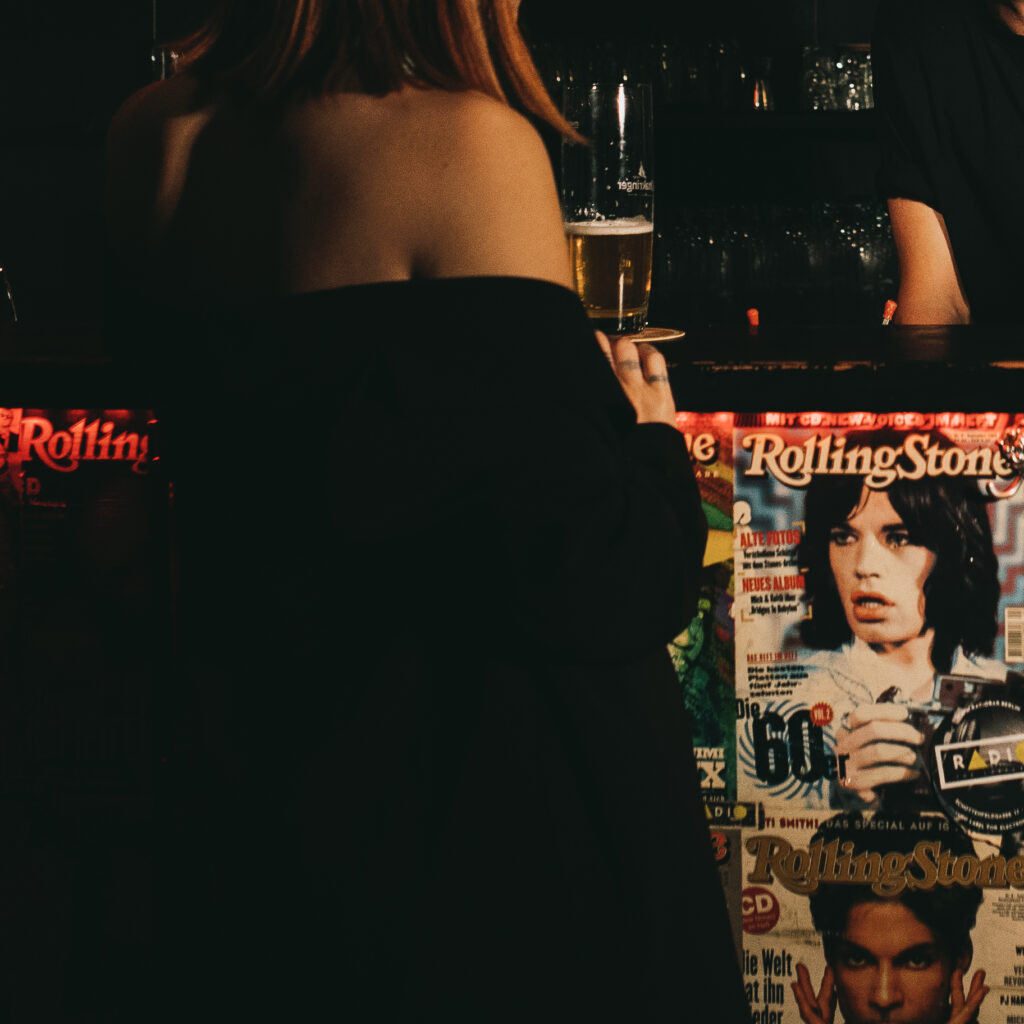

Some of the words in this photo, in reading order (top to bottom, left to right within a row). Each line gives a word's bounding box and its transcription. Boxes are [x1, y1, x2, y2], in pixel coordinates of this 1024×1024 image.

[742, 432, 906, 489] Rolling
[897, 432, 1012, 481] Stone
[740, 530, 764, 548] ALTE
[767, 528, 801, 546] FOTOS
[742, 576, 772, 593] NEUES
[773, 574, 806, 591] ALBUM
[736, 697, 760, 721] Die
[779, 818, 819, 830] SMITH!
[825, 819, 849, 831] DAS
[855, 820, 905, 832] SPECIAL
[910, 820, 934, 833] AUF
[745, 835, 910, 898] Rolling
[742, 894, 774, 917] CD
[761, 949, 792, 976] Welt
[745, 980, 760, 1003] at
[763, 977, 784, 1004] ihn
[1000, 995, 1010, 1006] PJ
